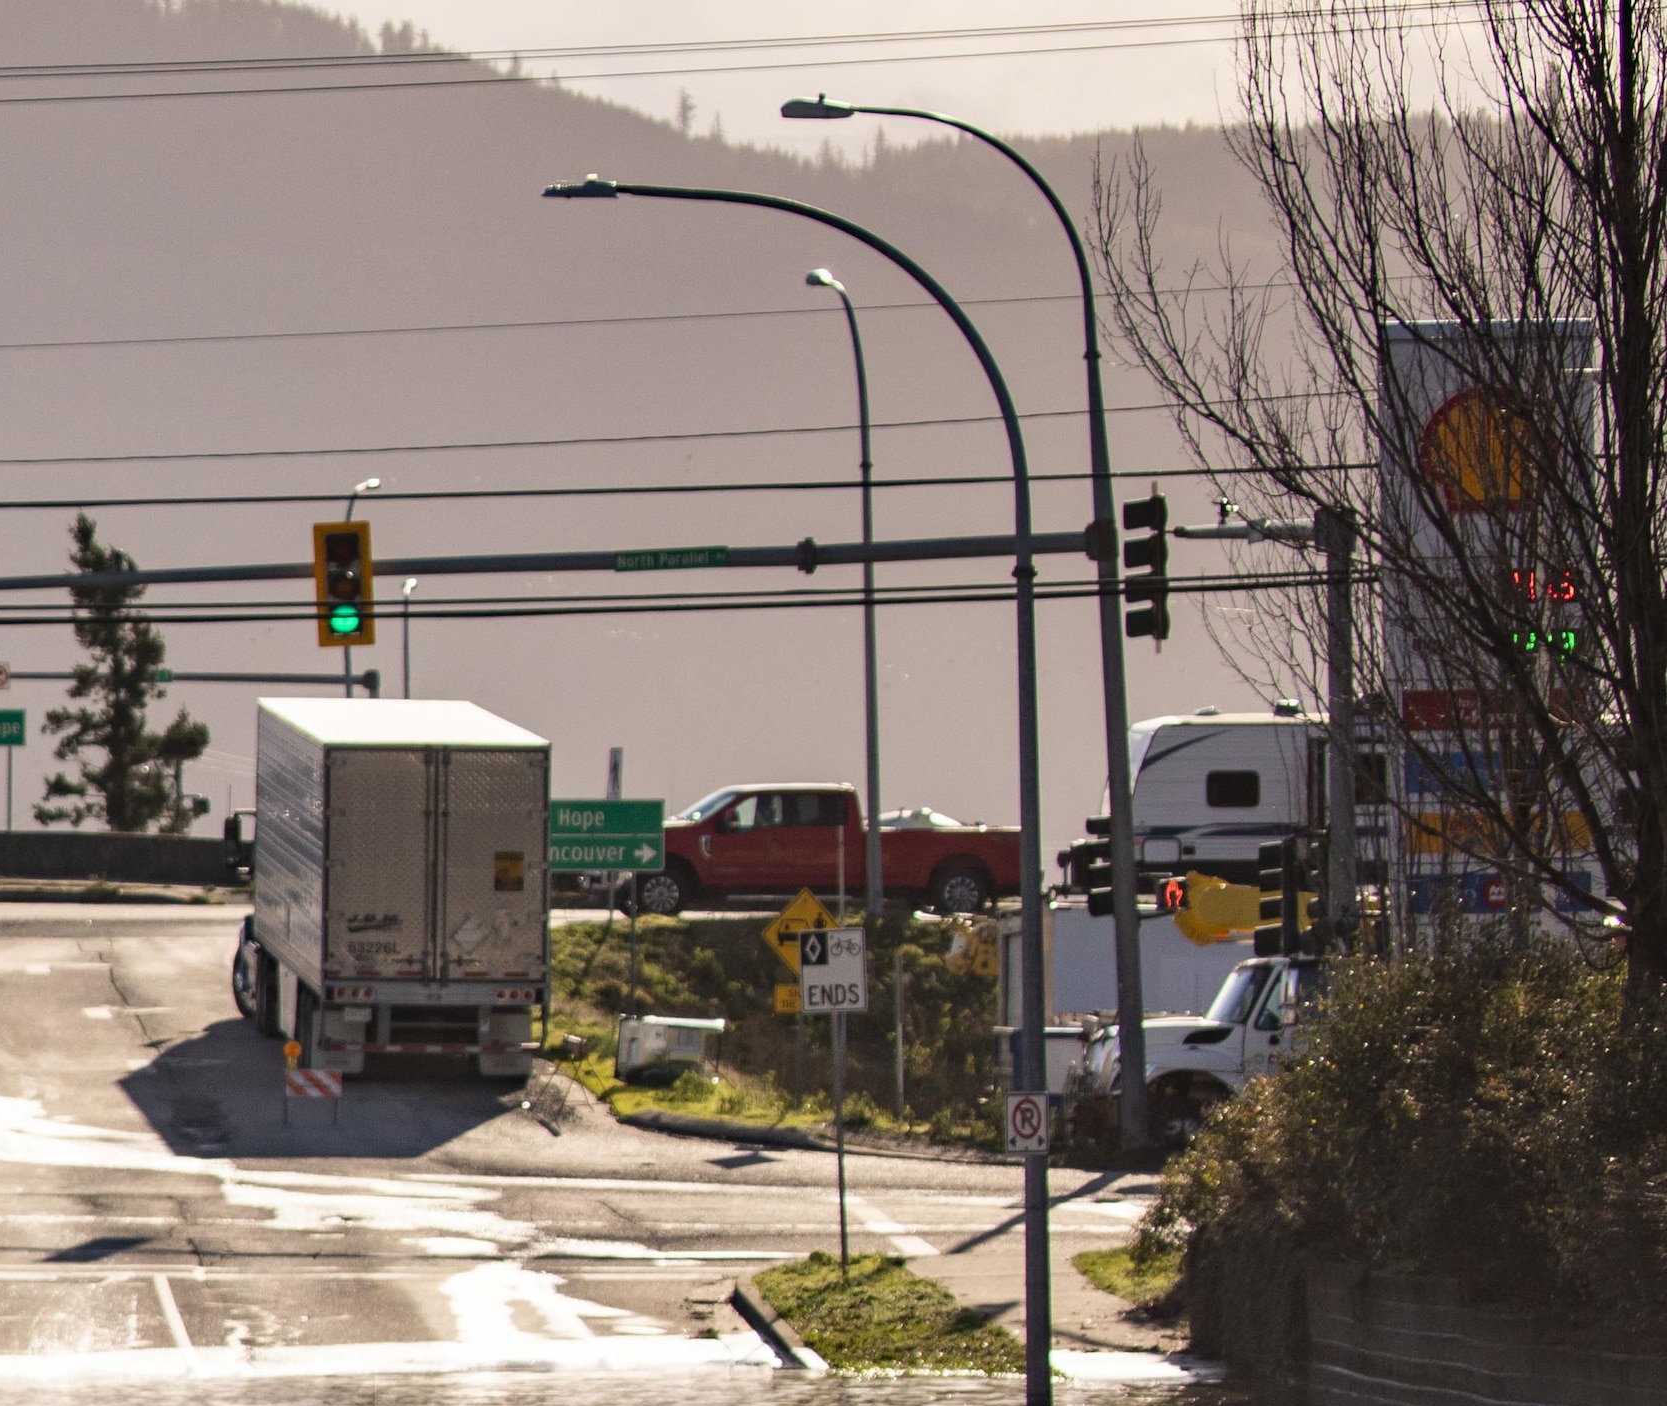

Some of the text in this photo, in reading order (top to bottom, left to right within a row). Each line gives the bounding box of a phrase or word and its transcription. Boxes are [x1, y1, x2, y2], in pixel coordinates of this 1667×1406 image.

[617, 554, 655, 568] North
[660, 551, 710, 566] Parallel
[559, 808, 605, 831] Hope
[549, 845, 626, 861] ncouver
[809, 984, 860, 1005] ENDS
